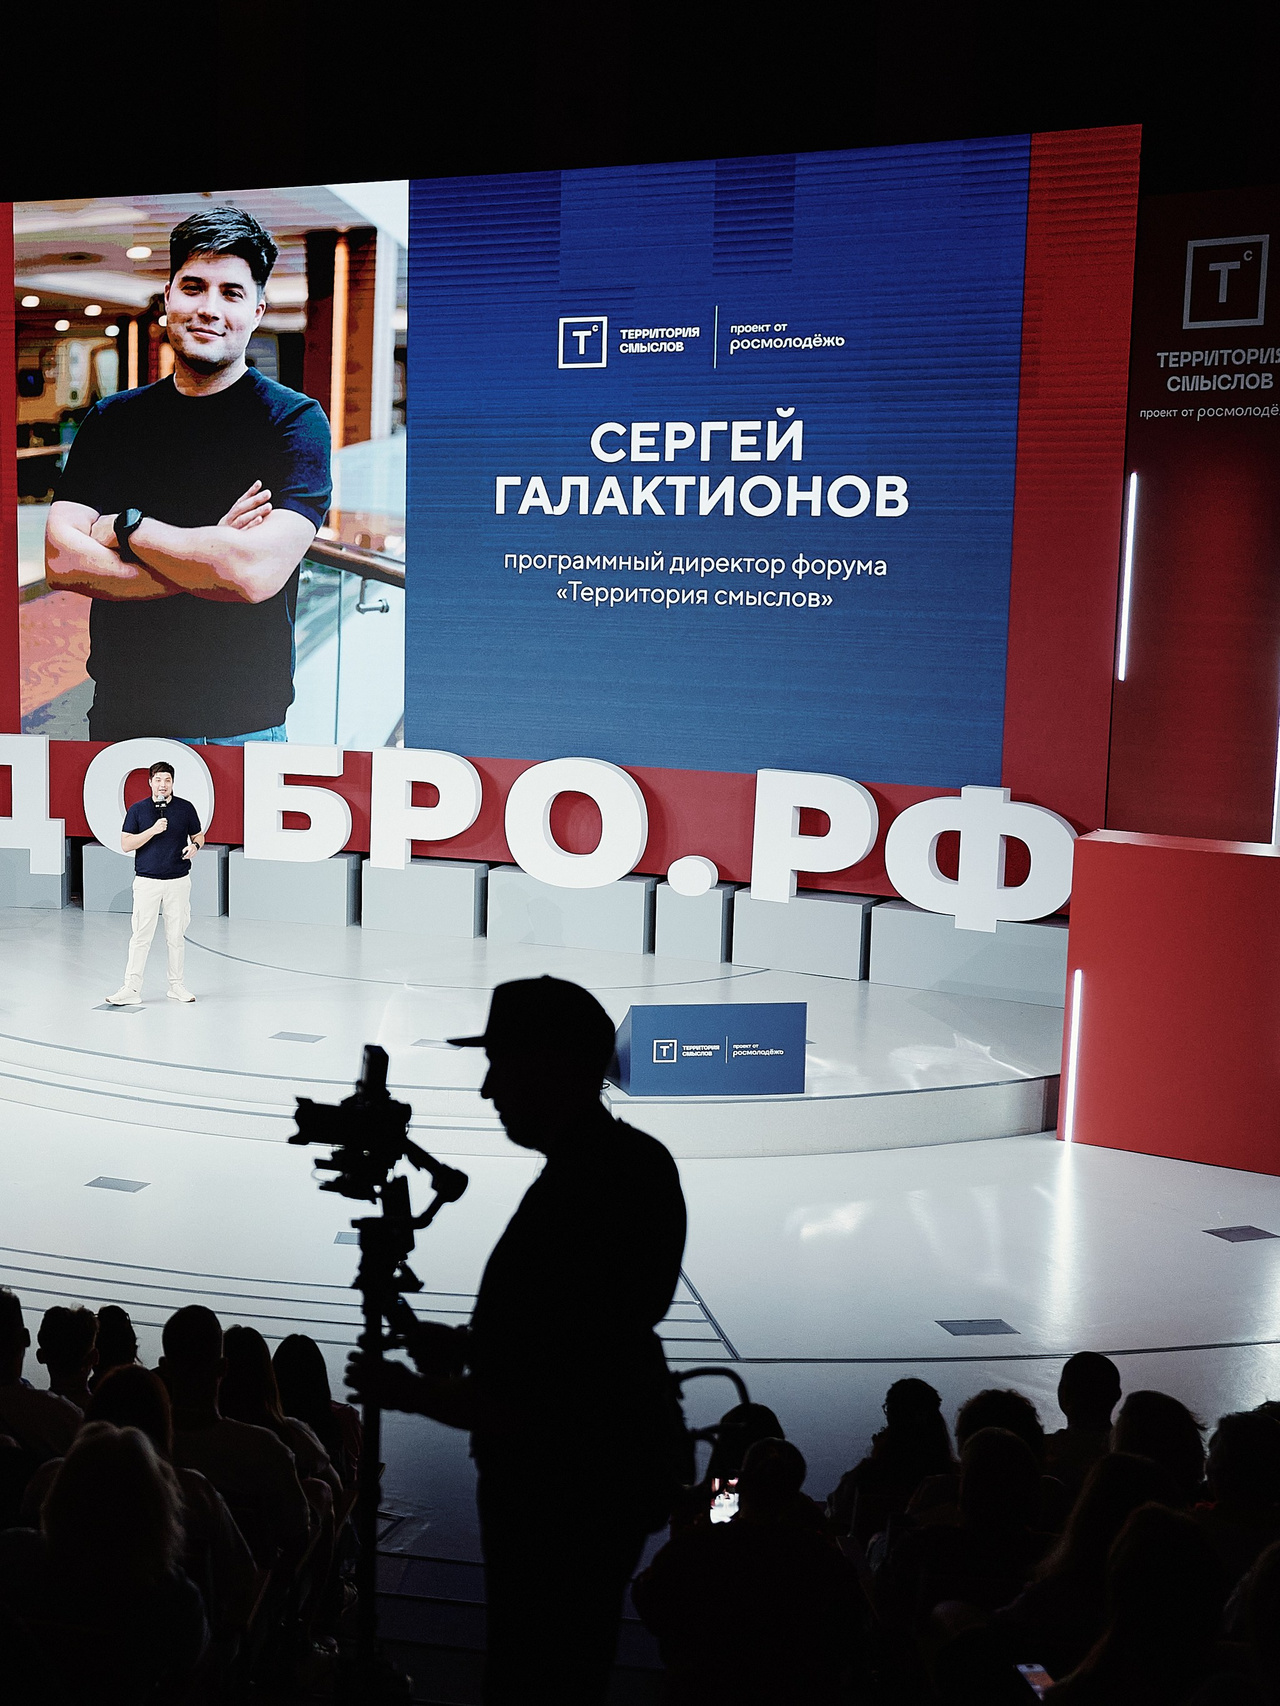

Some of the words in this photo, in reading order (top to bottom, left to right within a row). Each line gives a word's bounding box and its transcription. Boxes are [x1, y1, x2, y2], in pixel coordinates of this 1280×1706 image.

[619, 326, 700, 340] ТЕРРИТОРИЯ
[730, 324, 771, 335] проект
[773, 322, 788, 333] от
[619, 341, 685, 354] СМЫСЛОВ
[730, 334, 846, 355] росмолодёжь
[1166, 372, 1274, 392] СМЫСЛОВ
[1139, 408, 1179, 420] проект
[1181, 407, 1195, 417] от
[1197, 403, 1280, 421] росмолодё
[590, 406, 804, 463] СЕРГЕЙ
[495, 474, 909, 518] ГАЛАКТИОНОВ
[504, 551, 665, 575] программный
[669, 554, 786, 578] директор
[791, 553, 888, 582] форума
[556, 581, 709, 609] «Территория
[714, 590, 833, 608] смыслов»
